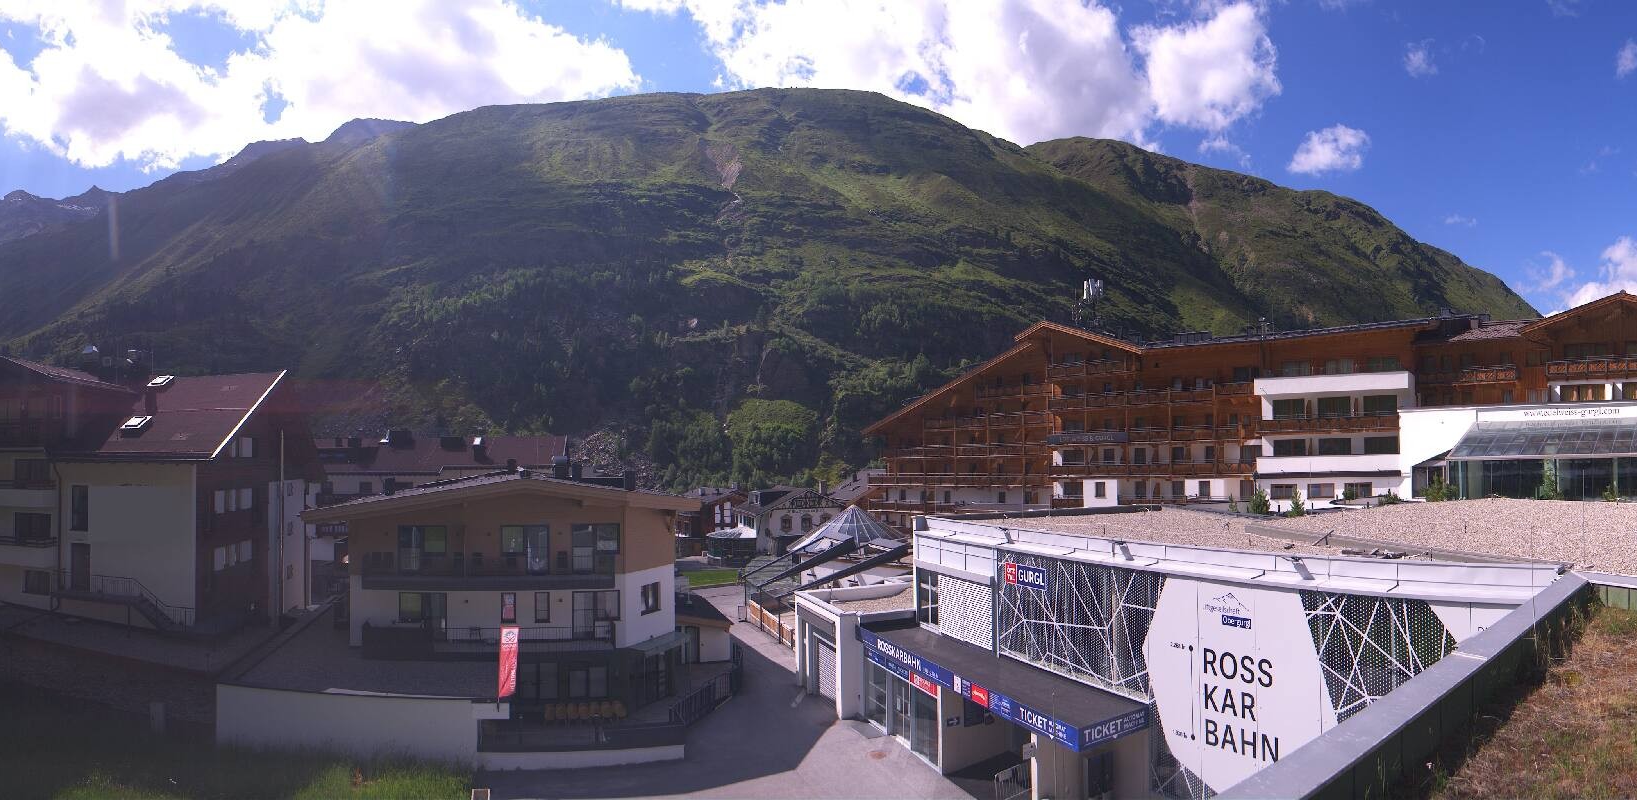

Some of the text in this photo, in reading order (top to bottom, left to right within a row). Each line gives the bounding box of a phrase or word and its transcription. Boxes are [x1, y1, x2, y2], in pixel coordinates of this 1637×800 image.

[1018, 569, 1045, 586] GURGL
[877, 639, 922, 671] ROSSKARBAHN
[1204, 648, 1273, 688] ROSS
[1204, 683, 1257, 721] KAR
[1019, 707, 1048, 731] TICKET
[1084, 719, 1124, 743] TICKET
[1205, 719, 1279, 763] BAHN
